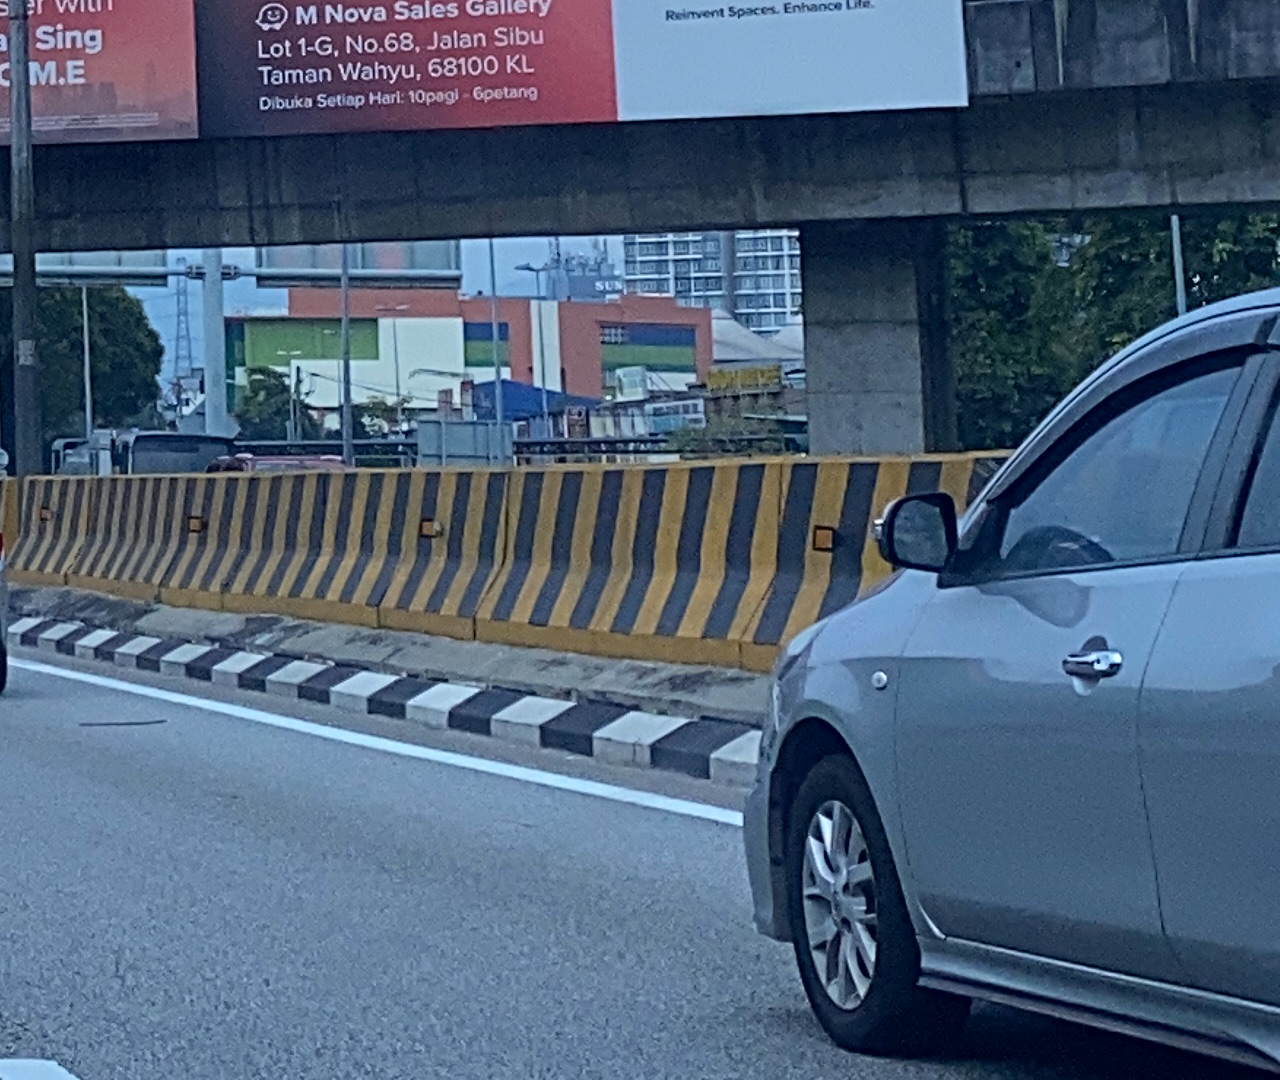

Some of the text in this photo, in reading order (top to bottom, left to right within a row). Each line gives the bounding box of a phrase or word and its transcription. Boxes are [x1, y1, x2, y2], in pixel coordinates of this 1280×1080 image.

[295, 5, 318, 25] M
[325, 3, 387, 25] Nova
[394, 0, 459, 20] Sales
[665, 6, 725, 21] Reinvent
[728, 4, 780, 20] Spaces.
[783, 0, 843, 14] Enhance
[35, 23, 103, 54] Sing
[257, 26, 544, 59] Lot 1-G, No.68, Jalan Sibu
[257, 54, 535, 85] Taman Wahyu, 68100 KL
[259, 95, 312, 111] Dibuka
[317, 91, 365, 109] Setiap
[369, 90, 404, 105] Hari:
[408, 87, 459, 105] 10pagi
[473, 85, 538, 103] 6petang
